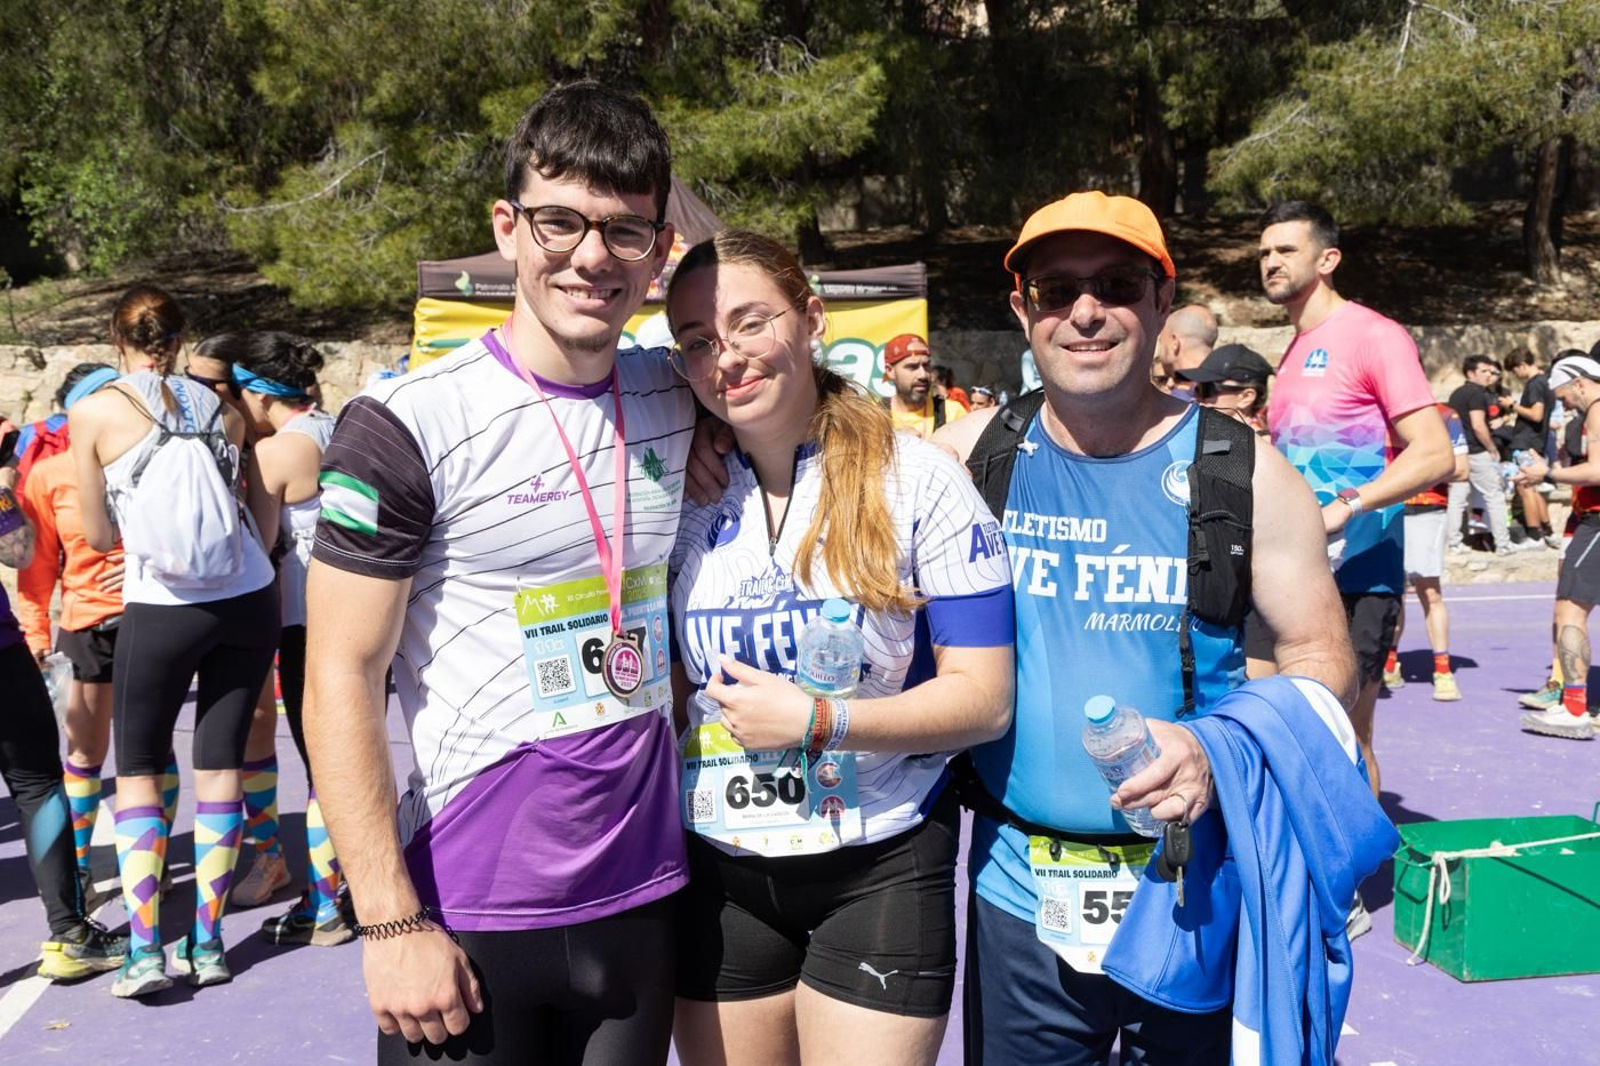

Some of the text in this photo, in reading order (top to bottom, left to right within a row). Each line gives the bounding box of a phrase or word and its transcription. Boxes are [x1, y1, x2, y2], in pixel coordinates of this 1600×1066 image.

[507, 490, 569, 505] TEAMERGY
[524, 613, 609, 639] VII TRAIL SOLIDARIO
[698, 758, 718, 769] TRAIL
[719, 754, 758, 768] SOLIDARIO
[725, 772, 806, 810] 650
[1035, 868, 1118, 879] VII TRAIL SOLIDARIO
